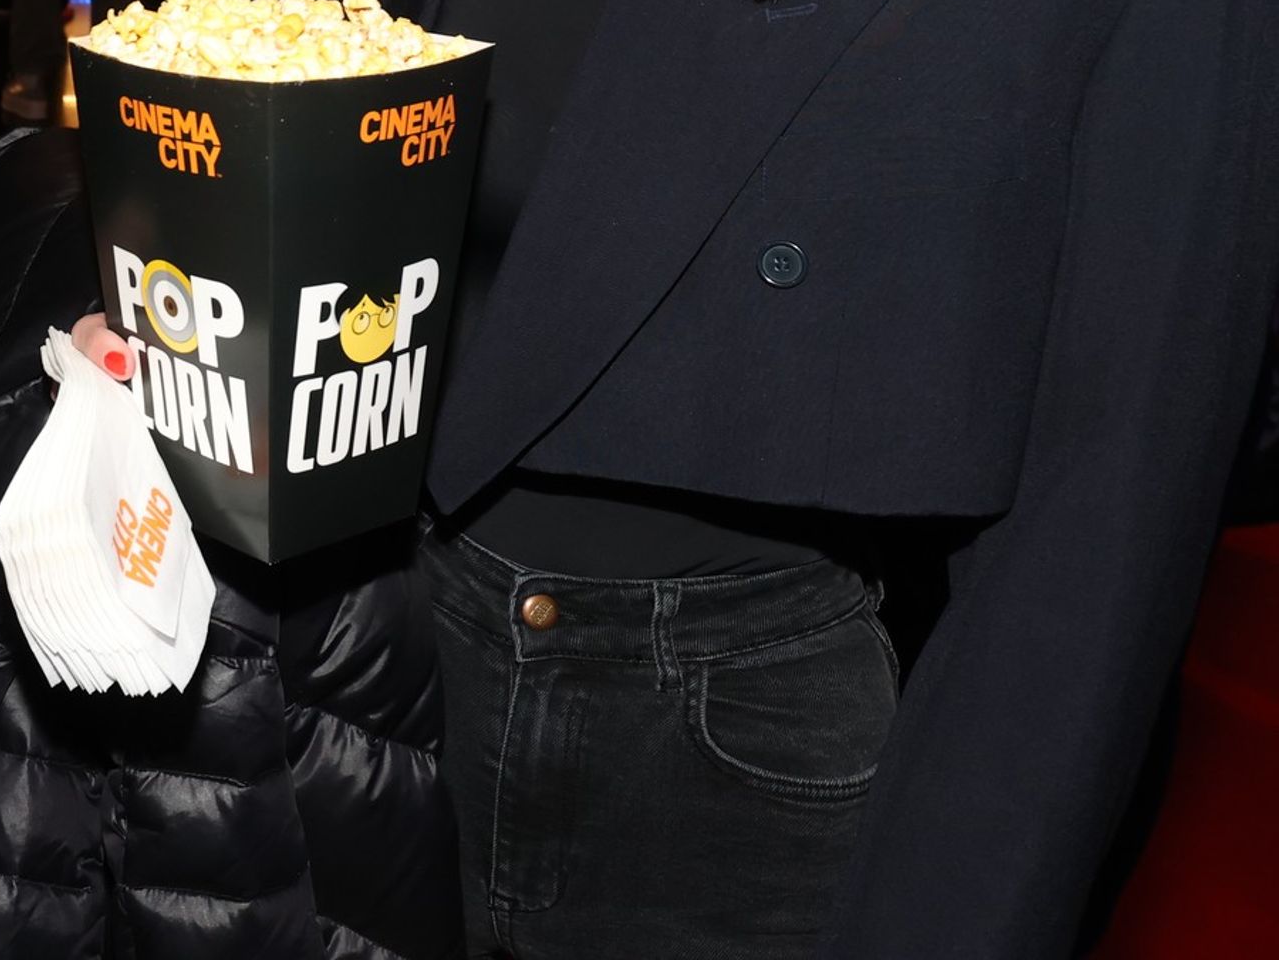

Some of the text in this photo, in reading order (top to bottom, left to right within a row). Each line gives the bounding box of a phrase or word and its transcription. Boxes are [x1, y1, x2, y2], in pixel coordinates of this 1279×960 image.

[119, 95, 221, 146] CINEMA
[359, 93, 456, 144] CINEMA
[401, 123, 456, 167] CITY
[158, 137, 222, 177] CITY
[113, 244, 245, 368] POP
[127, 335, 254, 475] CORN
[286, 344, 428, 474] CORN
[112, 498, 139, 573] CITY
[125, 487, 173, 588] CINEMA
